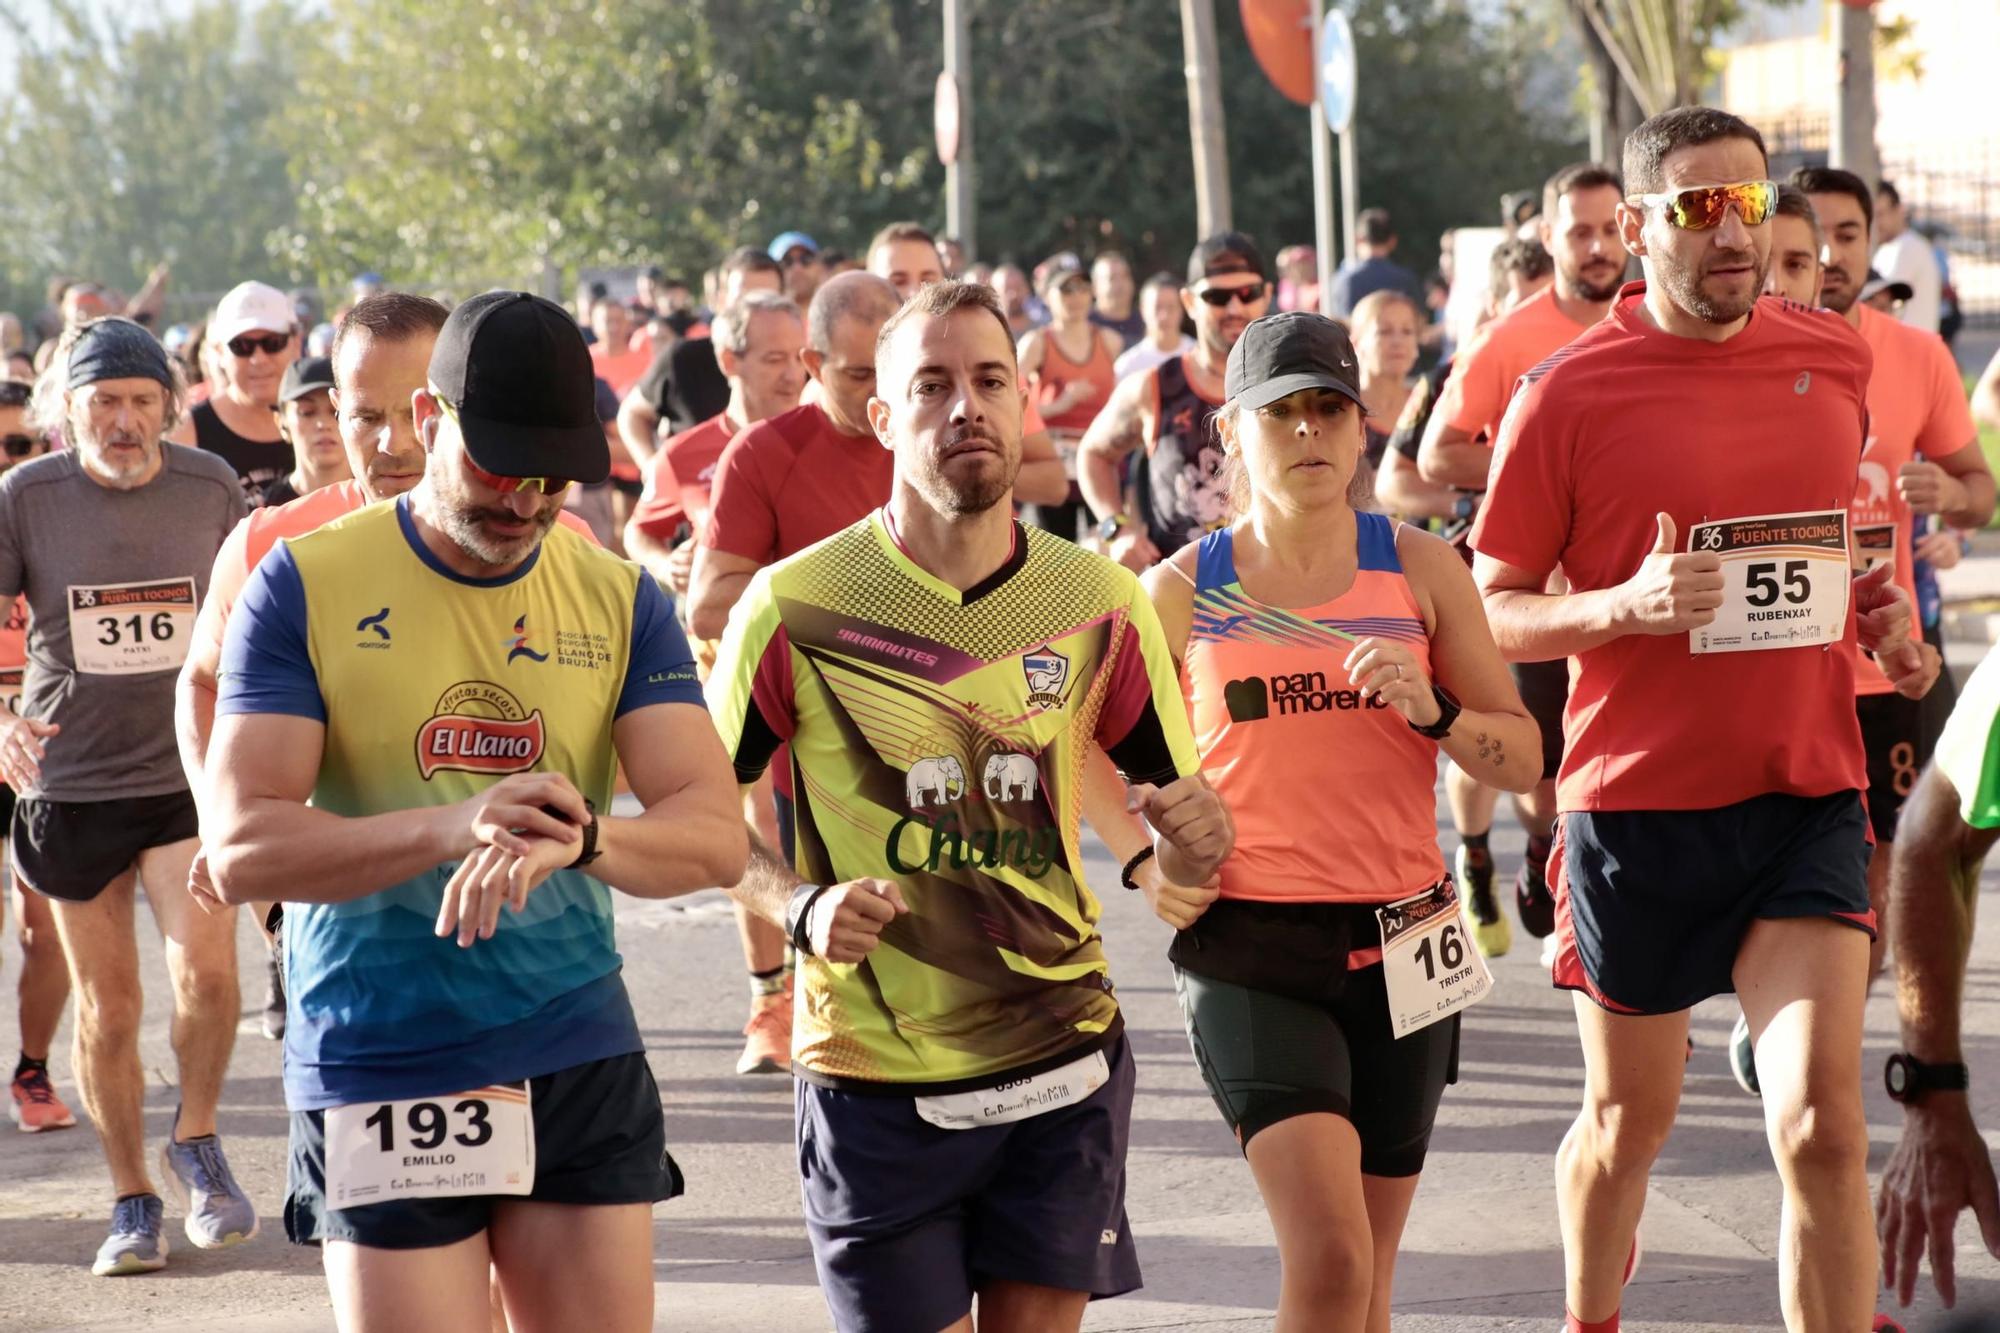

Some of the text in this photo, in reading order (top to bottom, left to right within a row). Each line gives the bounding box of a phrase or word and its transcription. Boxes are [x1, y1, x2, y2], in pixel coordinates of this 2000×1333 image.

[1732, 528, 1788, 545] PUENTE
[1790, 524, 1840, 540] TOCINOS
[101, 593, 142, 604] PUENTE
[144, 587, 189, 600] TOCINOS
[1745, 560, 1811, 607] 55
[1747, 608, 1812, 622] RUBENXAY
[97, 612, 174, 646] 316
[557, 647, 612, 662] LLANO DE
[558, 657, 600, 670] BRUJAS
[1270, 672, 1326, 702] pan
[444, 688, 514, 714] frutas secos
[431, 728, 532, 757] El Llano
[886, 813, 1058, 879] Chang
[1414, 925, 1463, 981] 16
[1439, 965, 1473, 989] TRISTRI
[366, 1099, 493, 1152] 193
[402, 1154, 456, 1167] EMILIO
